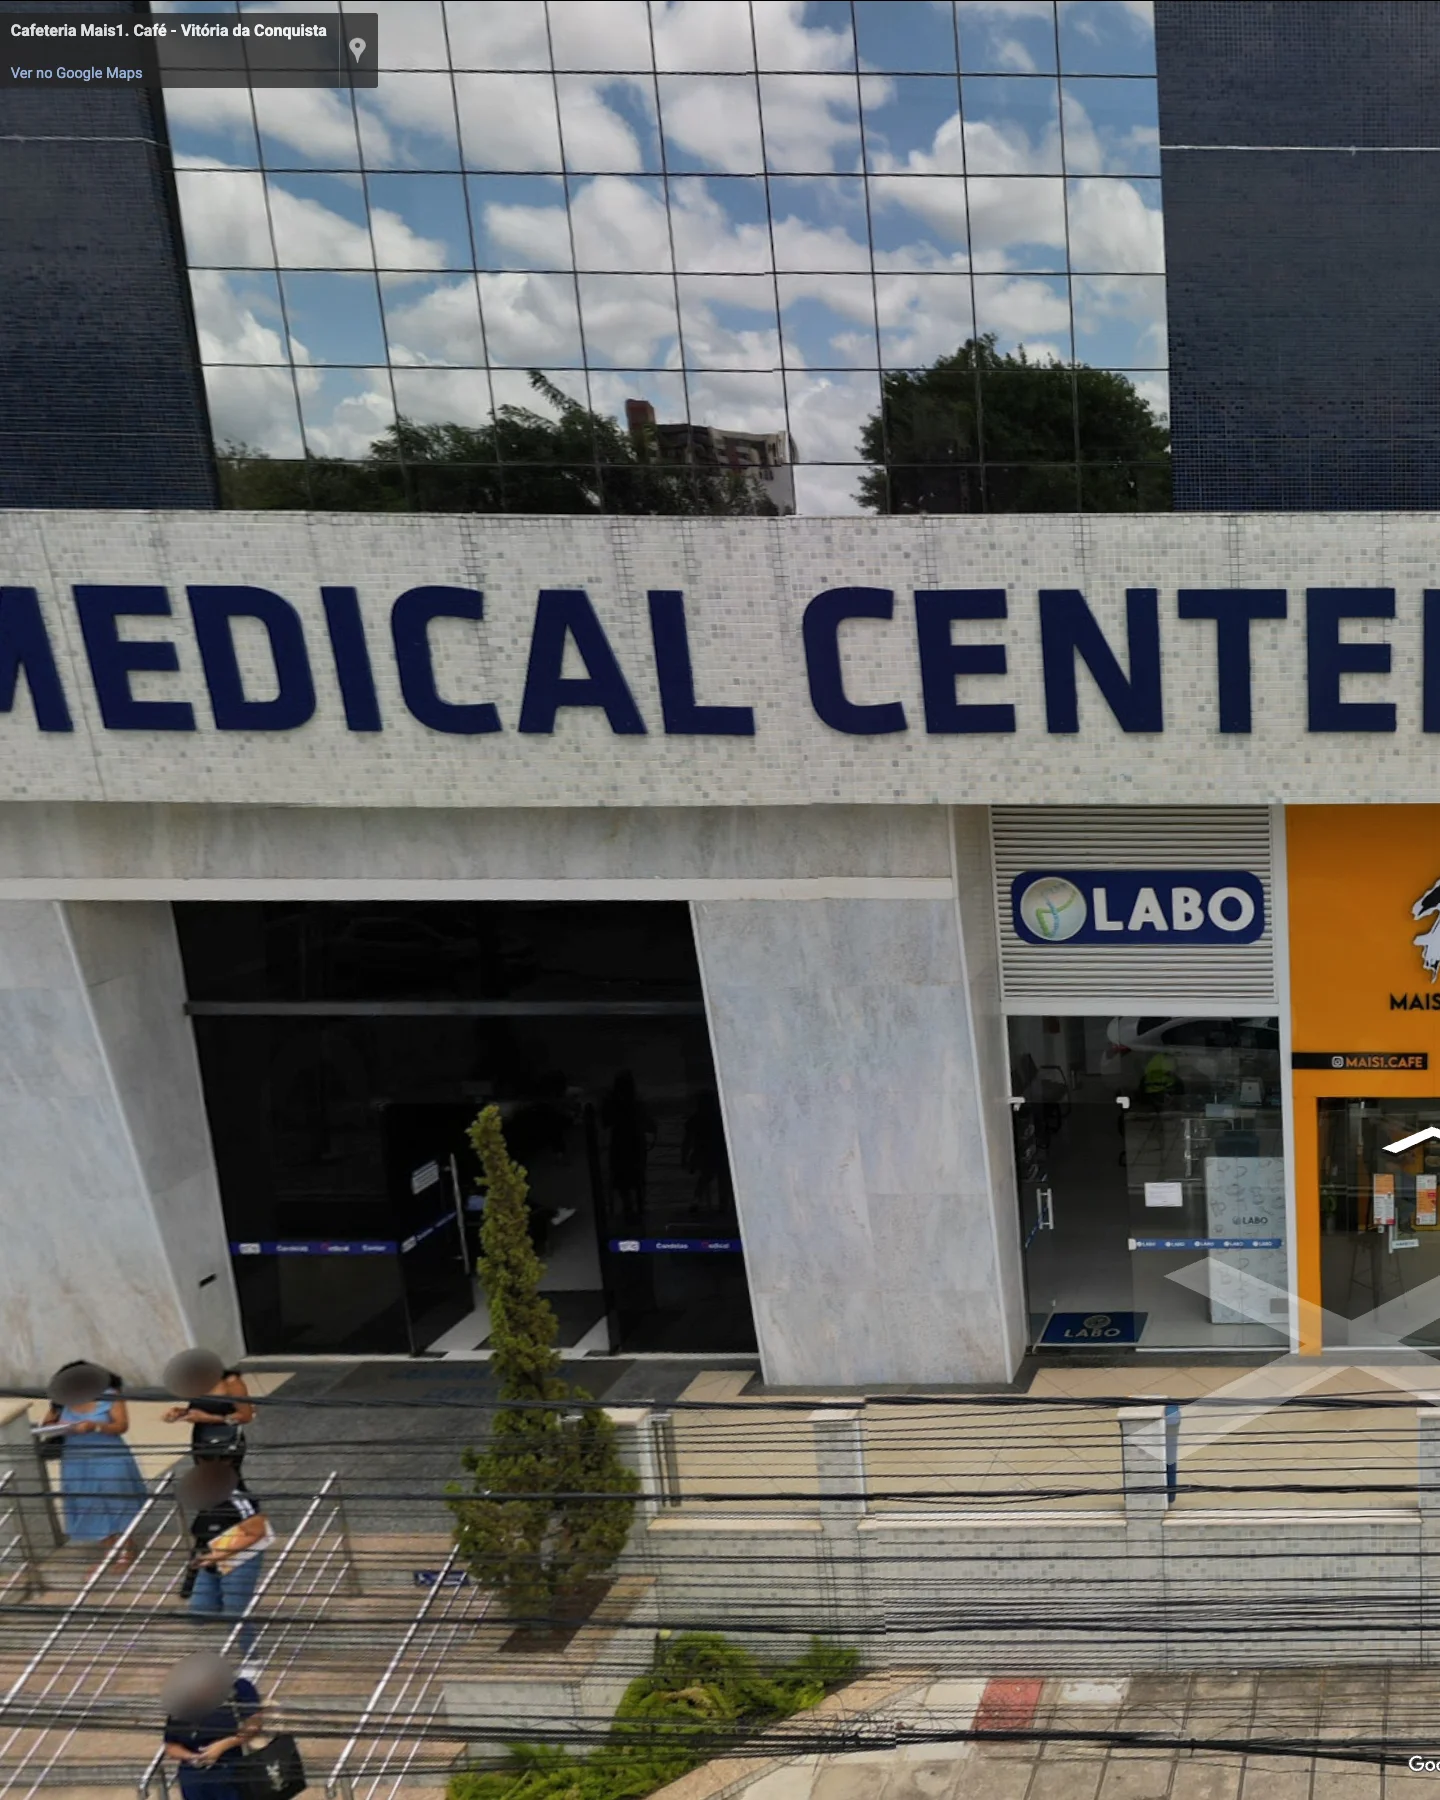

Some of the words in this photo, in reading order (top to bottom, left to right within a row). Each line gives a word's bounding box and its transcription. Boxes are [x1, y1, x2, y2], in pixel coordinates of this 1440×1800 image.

[1092, 886, 1256, 932] LABO
[1242, 1216, 1269, 1225] LABO
[1063, 1327, 1121, 1338] LABO
